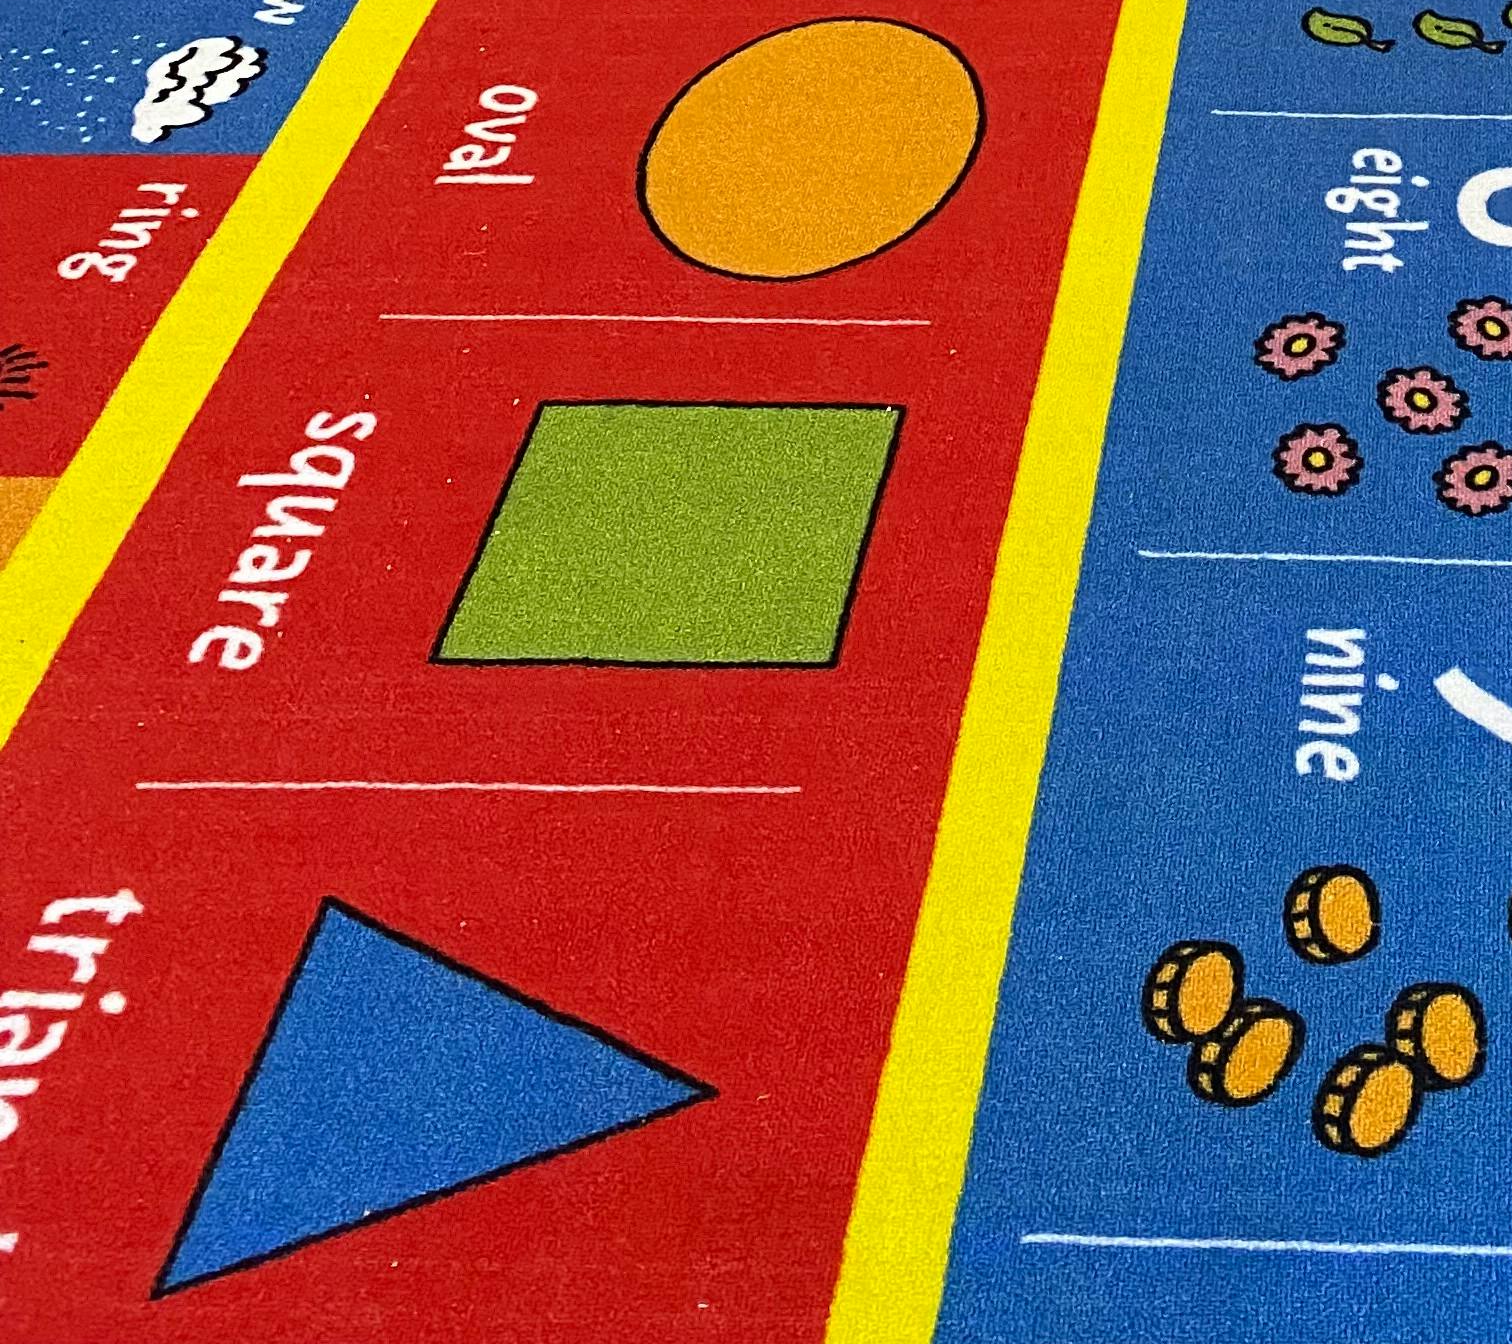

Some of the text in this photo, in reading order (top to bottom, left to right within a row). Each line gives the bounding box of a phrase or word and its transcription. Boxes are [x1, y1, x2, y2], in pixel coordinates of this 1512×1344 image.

[435, 85, 537, 184] oval
[58, 183, 199, 282] ring
[1325, 148, 1429, 272] eight
[189, 412, 377, 669] square
[1296, 628, 1399, 781] nine
